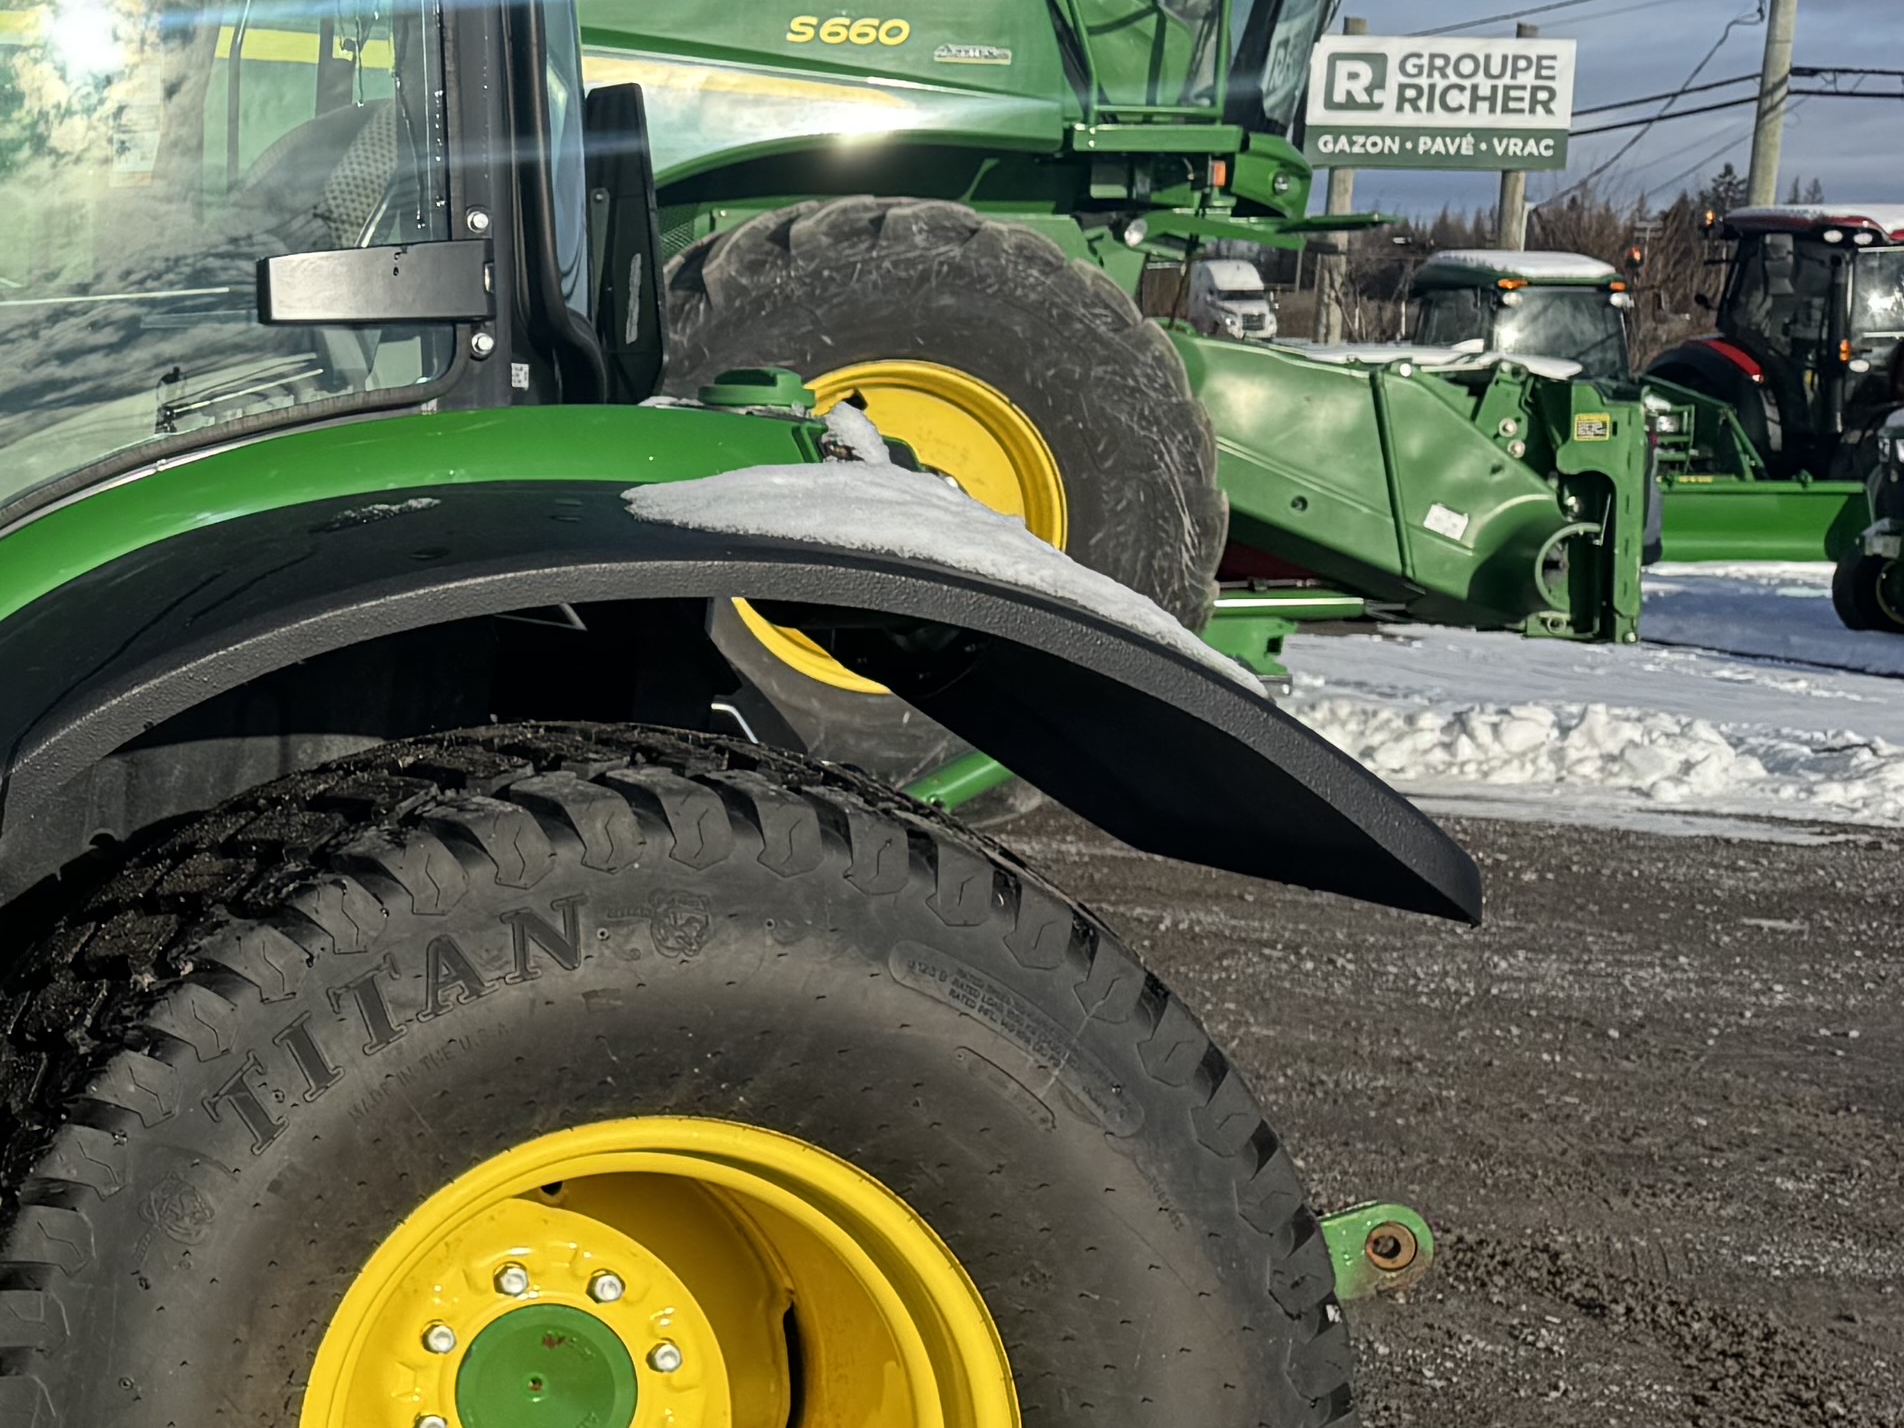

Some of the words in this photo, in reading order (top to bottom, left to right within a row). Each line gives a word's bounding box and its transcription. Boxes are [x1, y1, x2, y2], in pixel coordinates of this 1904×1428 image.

[786, 15, 911, 46] S660
[1398, 53, 1558, 81] GROUPE
[1395, 82, 1558, 116] RICHER
[1317, 135, 1401, 155] GAZON
[1418, 132, 1476, 156] PAVÉ
[1493, 138, 1555, 157] VRAC
[201, 893, 587, 1156] TITAN
